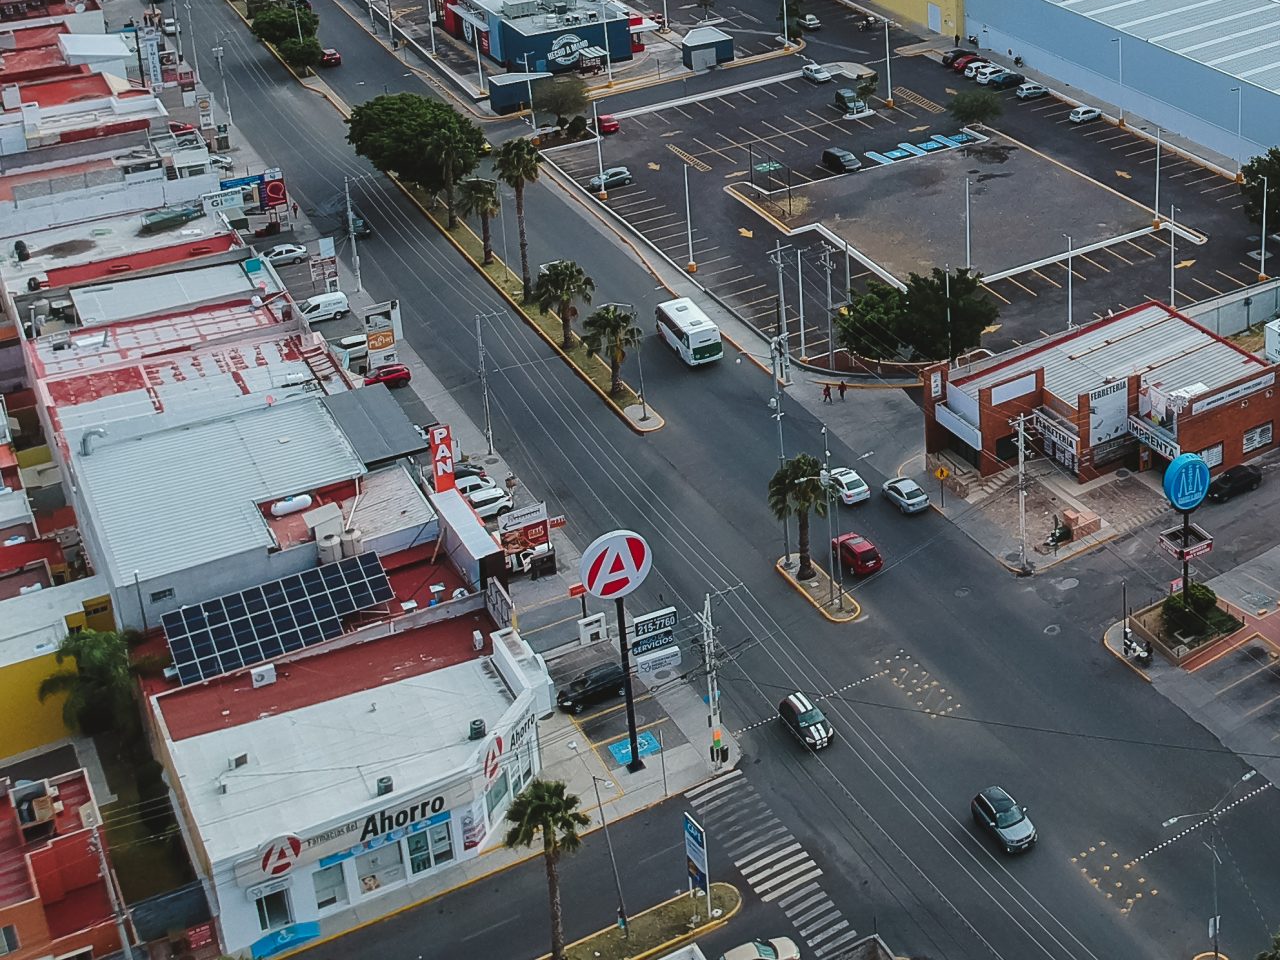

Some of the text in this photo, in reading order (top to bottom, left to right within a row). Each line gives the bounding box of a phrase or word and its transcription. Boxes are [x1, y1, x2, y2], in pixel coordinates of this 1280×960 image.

[433, 428, 454, 476] PAN
[1128, 420, 1176, 460] IMPRENTA
[638, 616, 675, 635] 215-7760
[633, 636, 673, 655] SERVICIOS
[510, 713, 535, 751] Ahorro
[360, 796, 446, 841] Ahorro
